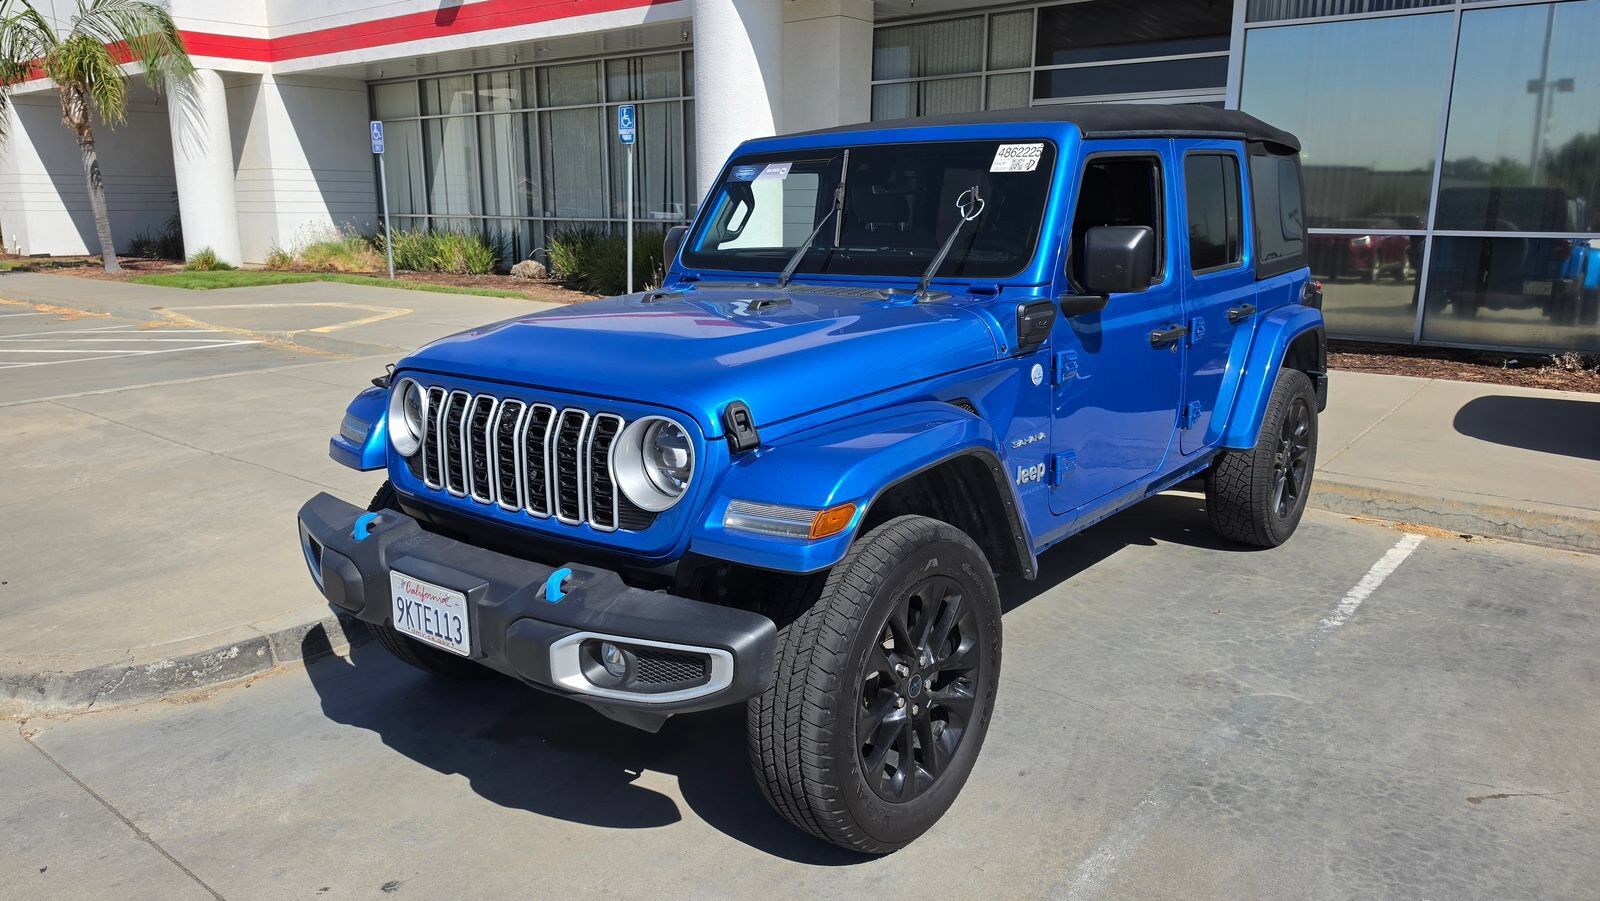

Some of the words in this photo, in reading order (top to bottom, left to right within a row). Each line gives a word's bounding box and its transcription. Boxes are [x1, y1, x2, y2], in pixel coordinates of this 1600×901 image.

[998, 146, 1043, 158] 4862225
[1016, 462, 1046, 485] Jeep
[405, 580, 451, 607] California
[397, 596, 463, 645] 9KTE113
